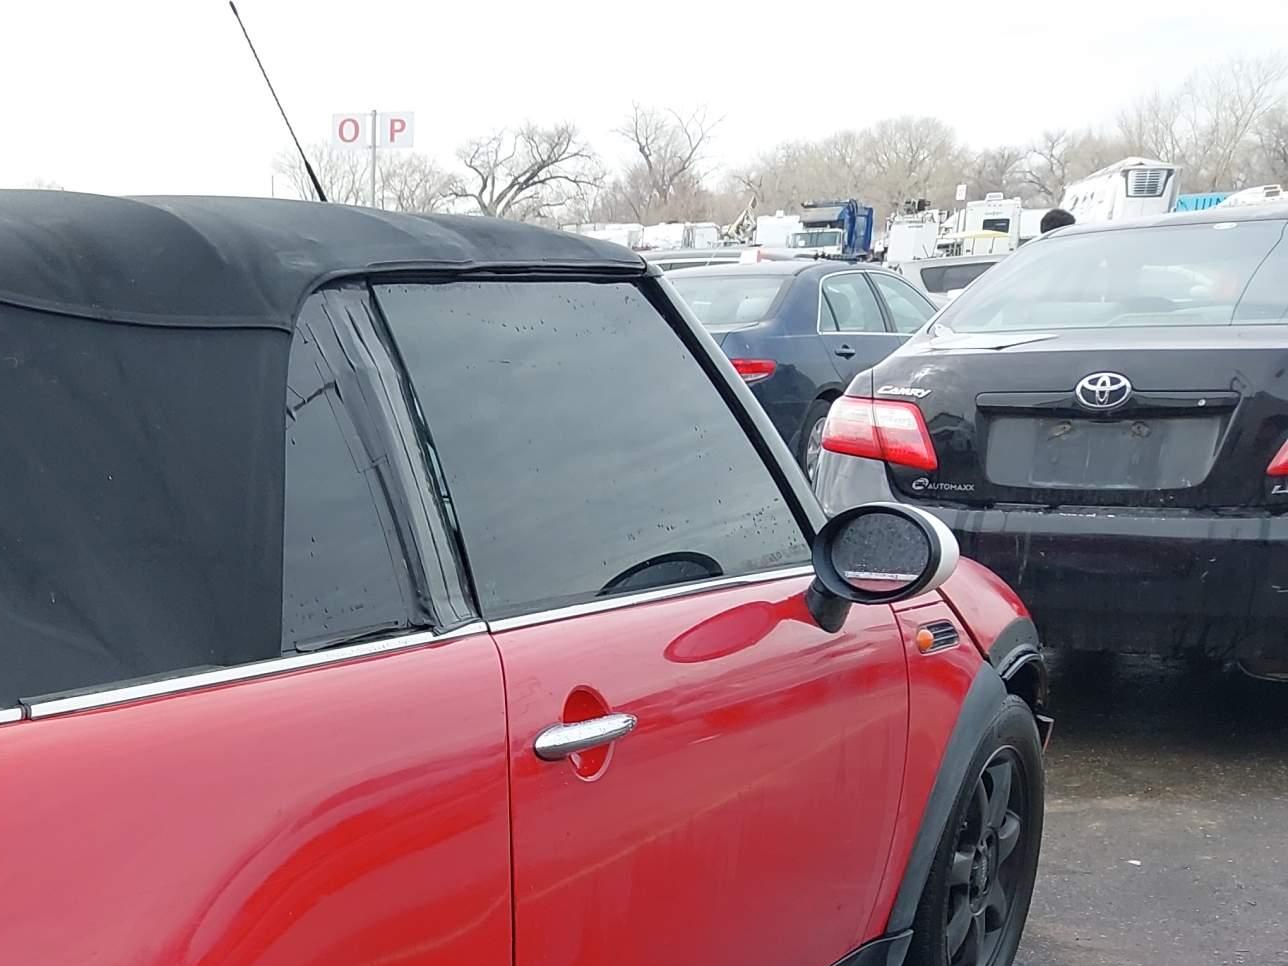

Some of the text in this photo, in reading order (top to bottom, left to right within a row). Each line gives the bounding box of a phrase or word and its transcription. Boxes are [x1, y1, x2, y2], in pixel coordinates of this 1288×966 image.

[338, 118, 407, 143] O P
[877, 386, 931, 399] CAMRY
[928, 483, 974, 491] AUTOMAXX
